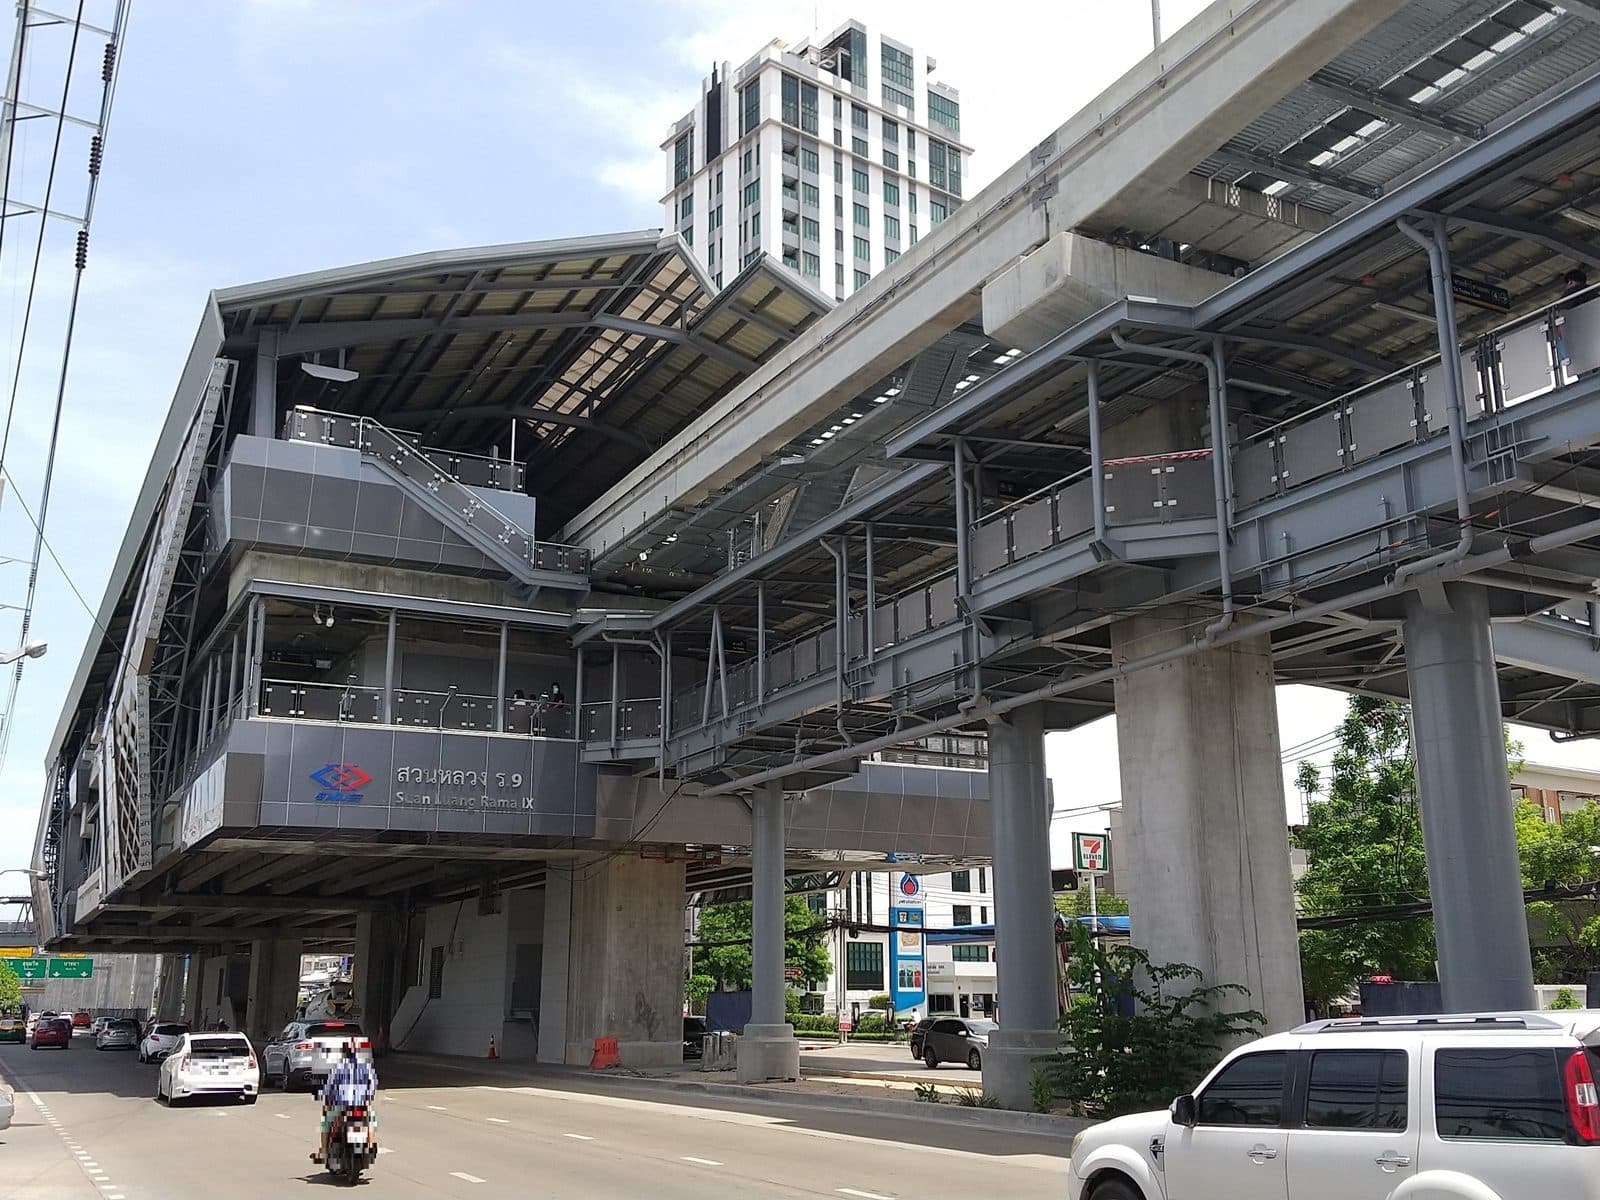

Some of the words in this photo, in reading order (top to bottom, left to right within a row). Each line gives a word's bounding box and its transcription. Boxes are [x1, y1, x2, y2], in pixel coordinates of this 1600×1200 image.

[397, 766, 488, 786] สวนหลวง
[480, 796, 517, 808] Rama
[522, 797, 534, 809] IX
